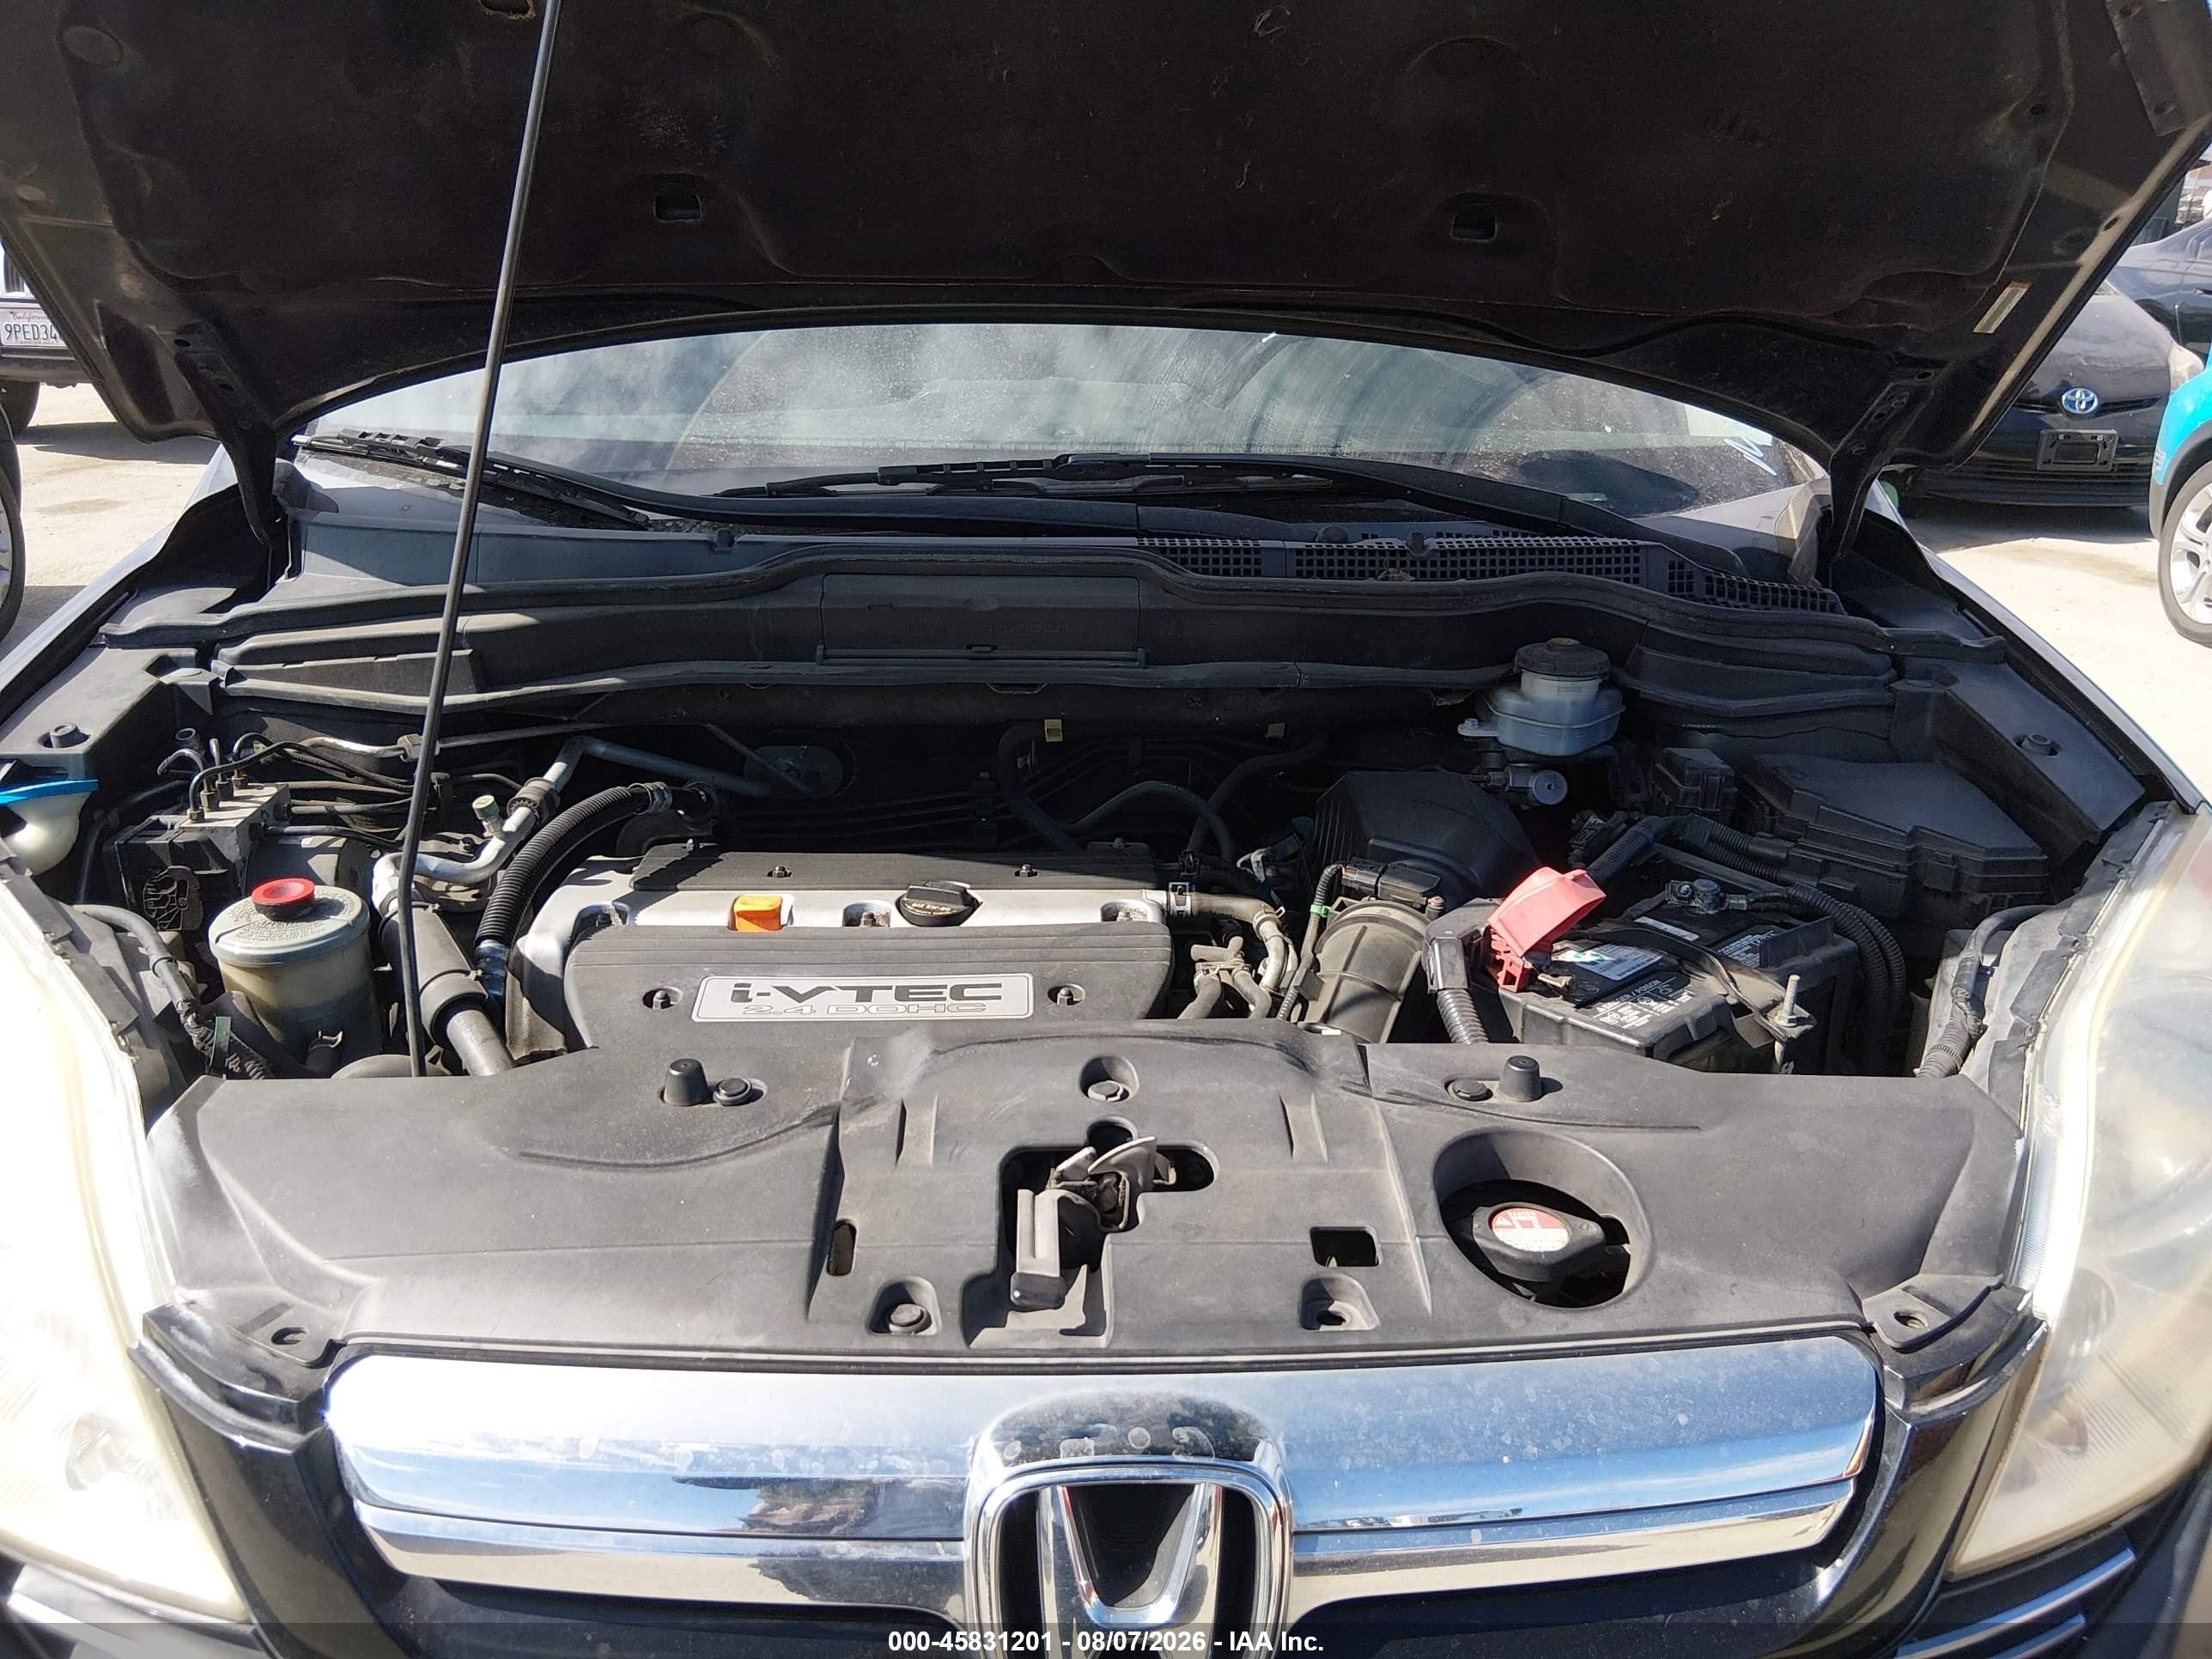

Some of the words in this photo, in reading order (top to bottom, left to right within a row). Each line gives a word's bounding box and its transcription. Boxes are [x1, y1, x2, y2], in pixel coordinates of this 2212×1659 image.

[730, 982, 1002, 1003] i-VTEC
[742, 1004, 817, 1015] 2.4
[826, 1003, 988, 1015] DOHC
